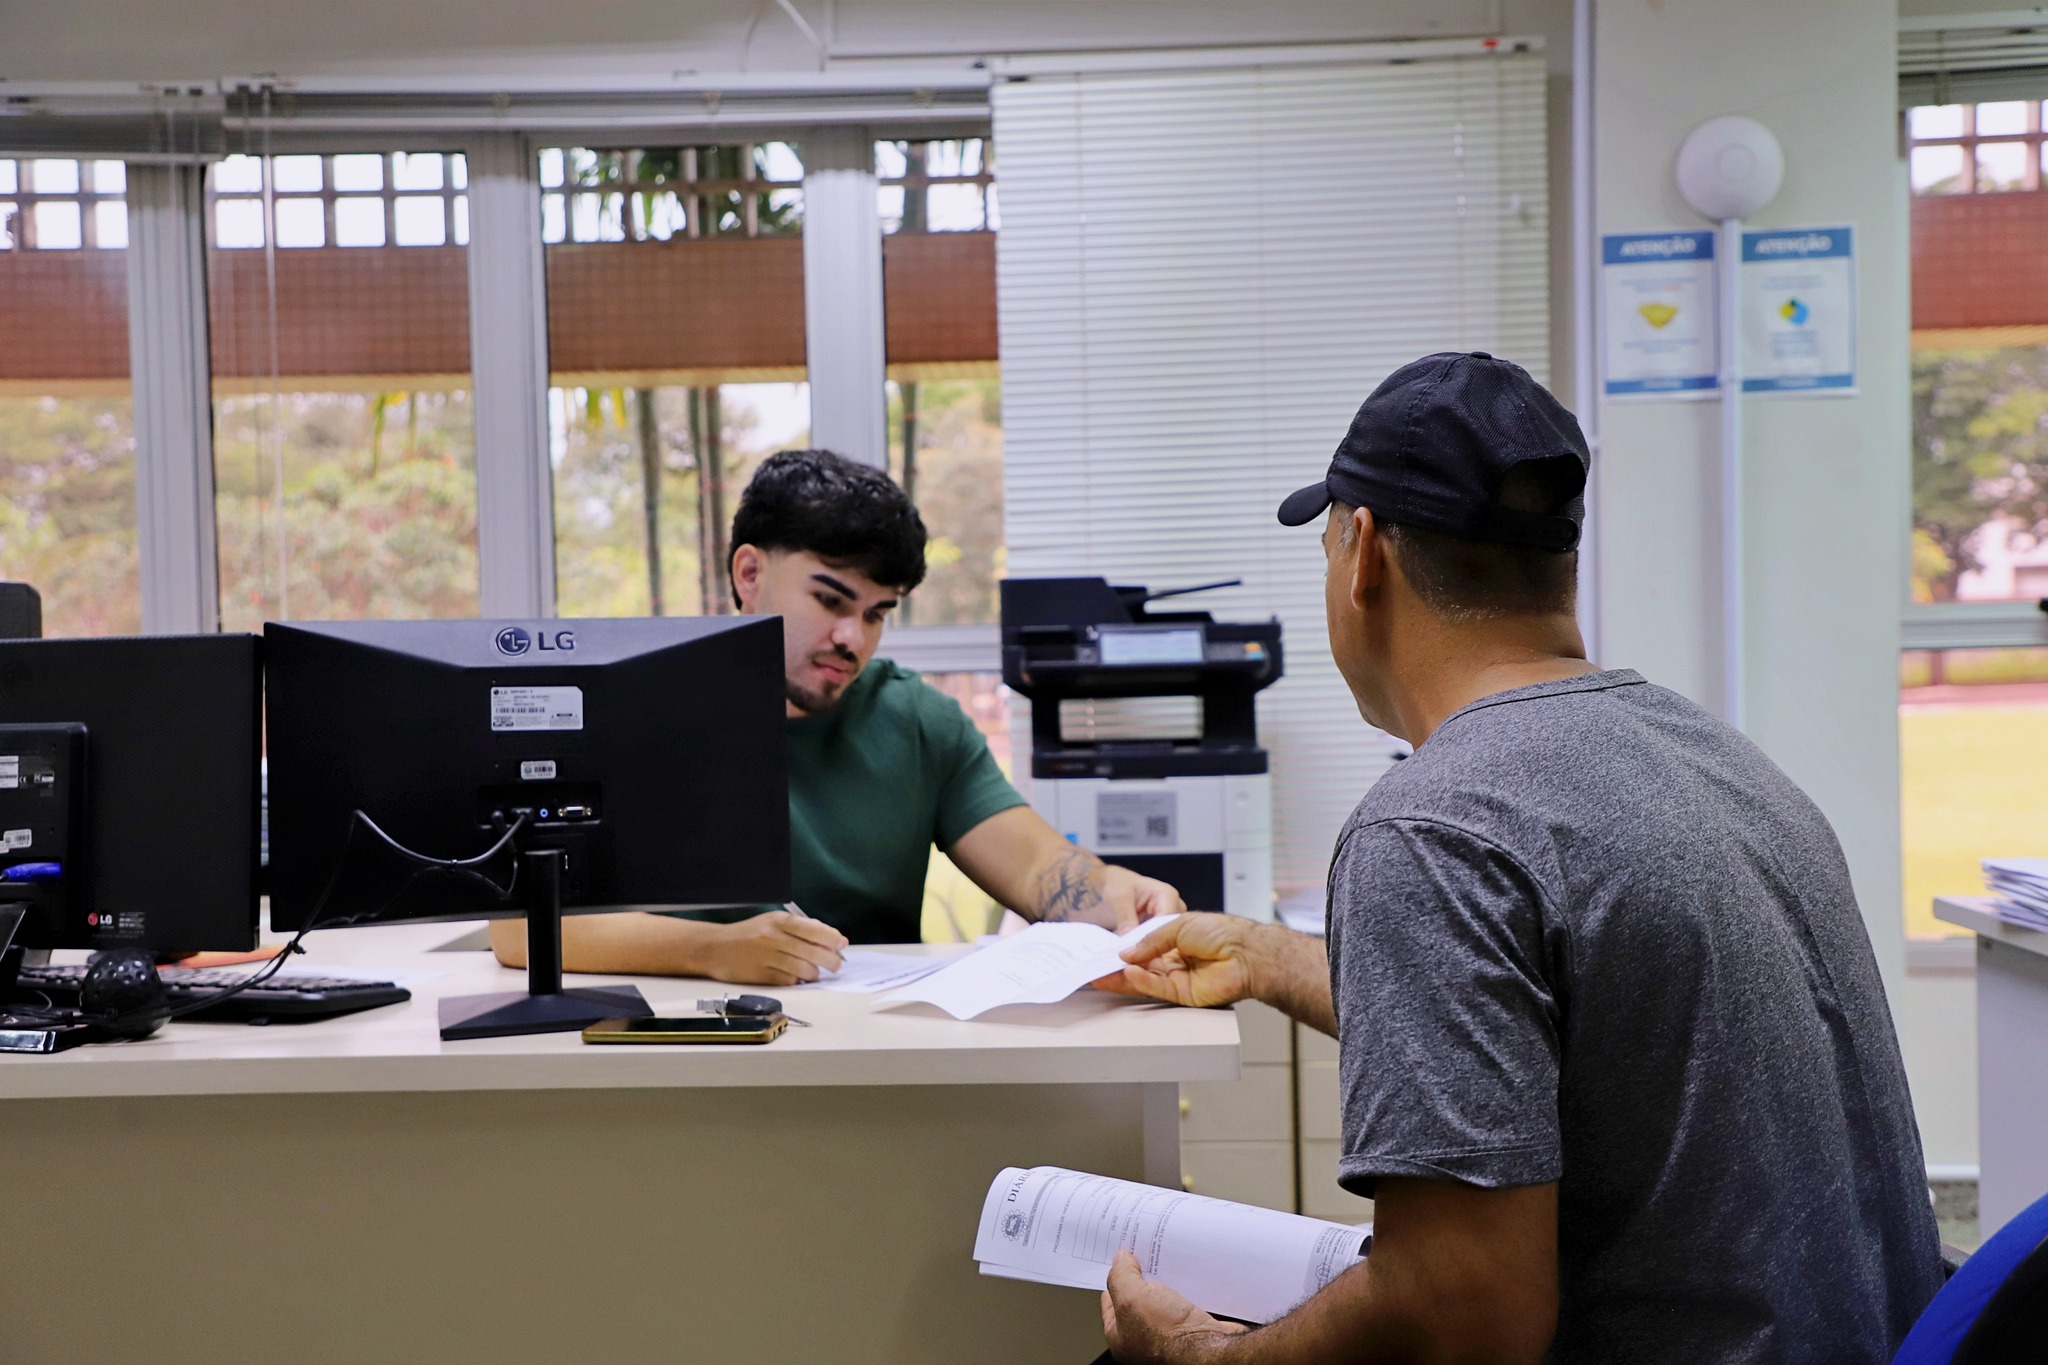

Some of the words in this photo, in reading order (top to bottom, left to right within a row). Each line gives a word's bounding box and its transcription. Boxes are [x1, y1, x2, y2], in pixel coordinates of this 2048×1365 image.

[1619, 236, 1697, 257] ATENÇÃO
[1754, 233, 1833, 255] ATENÇÃO
[538, 631, 575, 651] LG
[100, 914, 113, 925] LG
[1007, 1170, 1036, 1202] DIÁRIO
[1052, 1223, 1064, 1254] PROGRAMA
